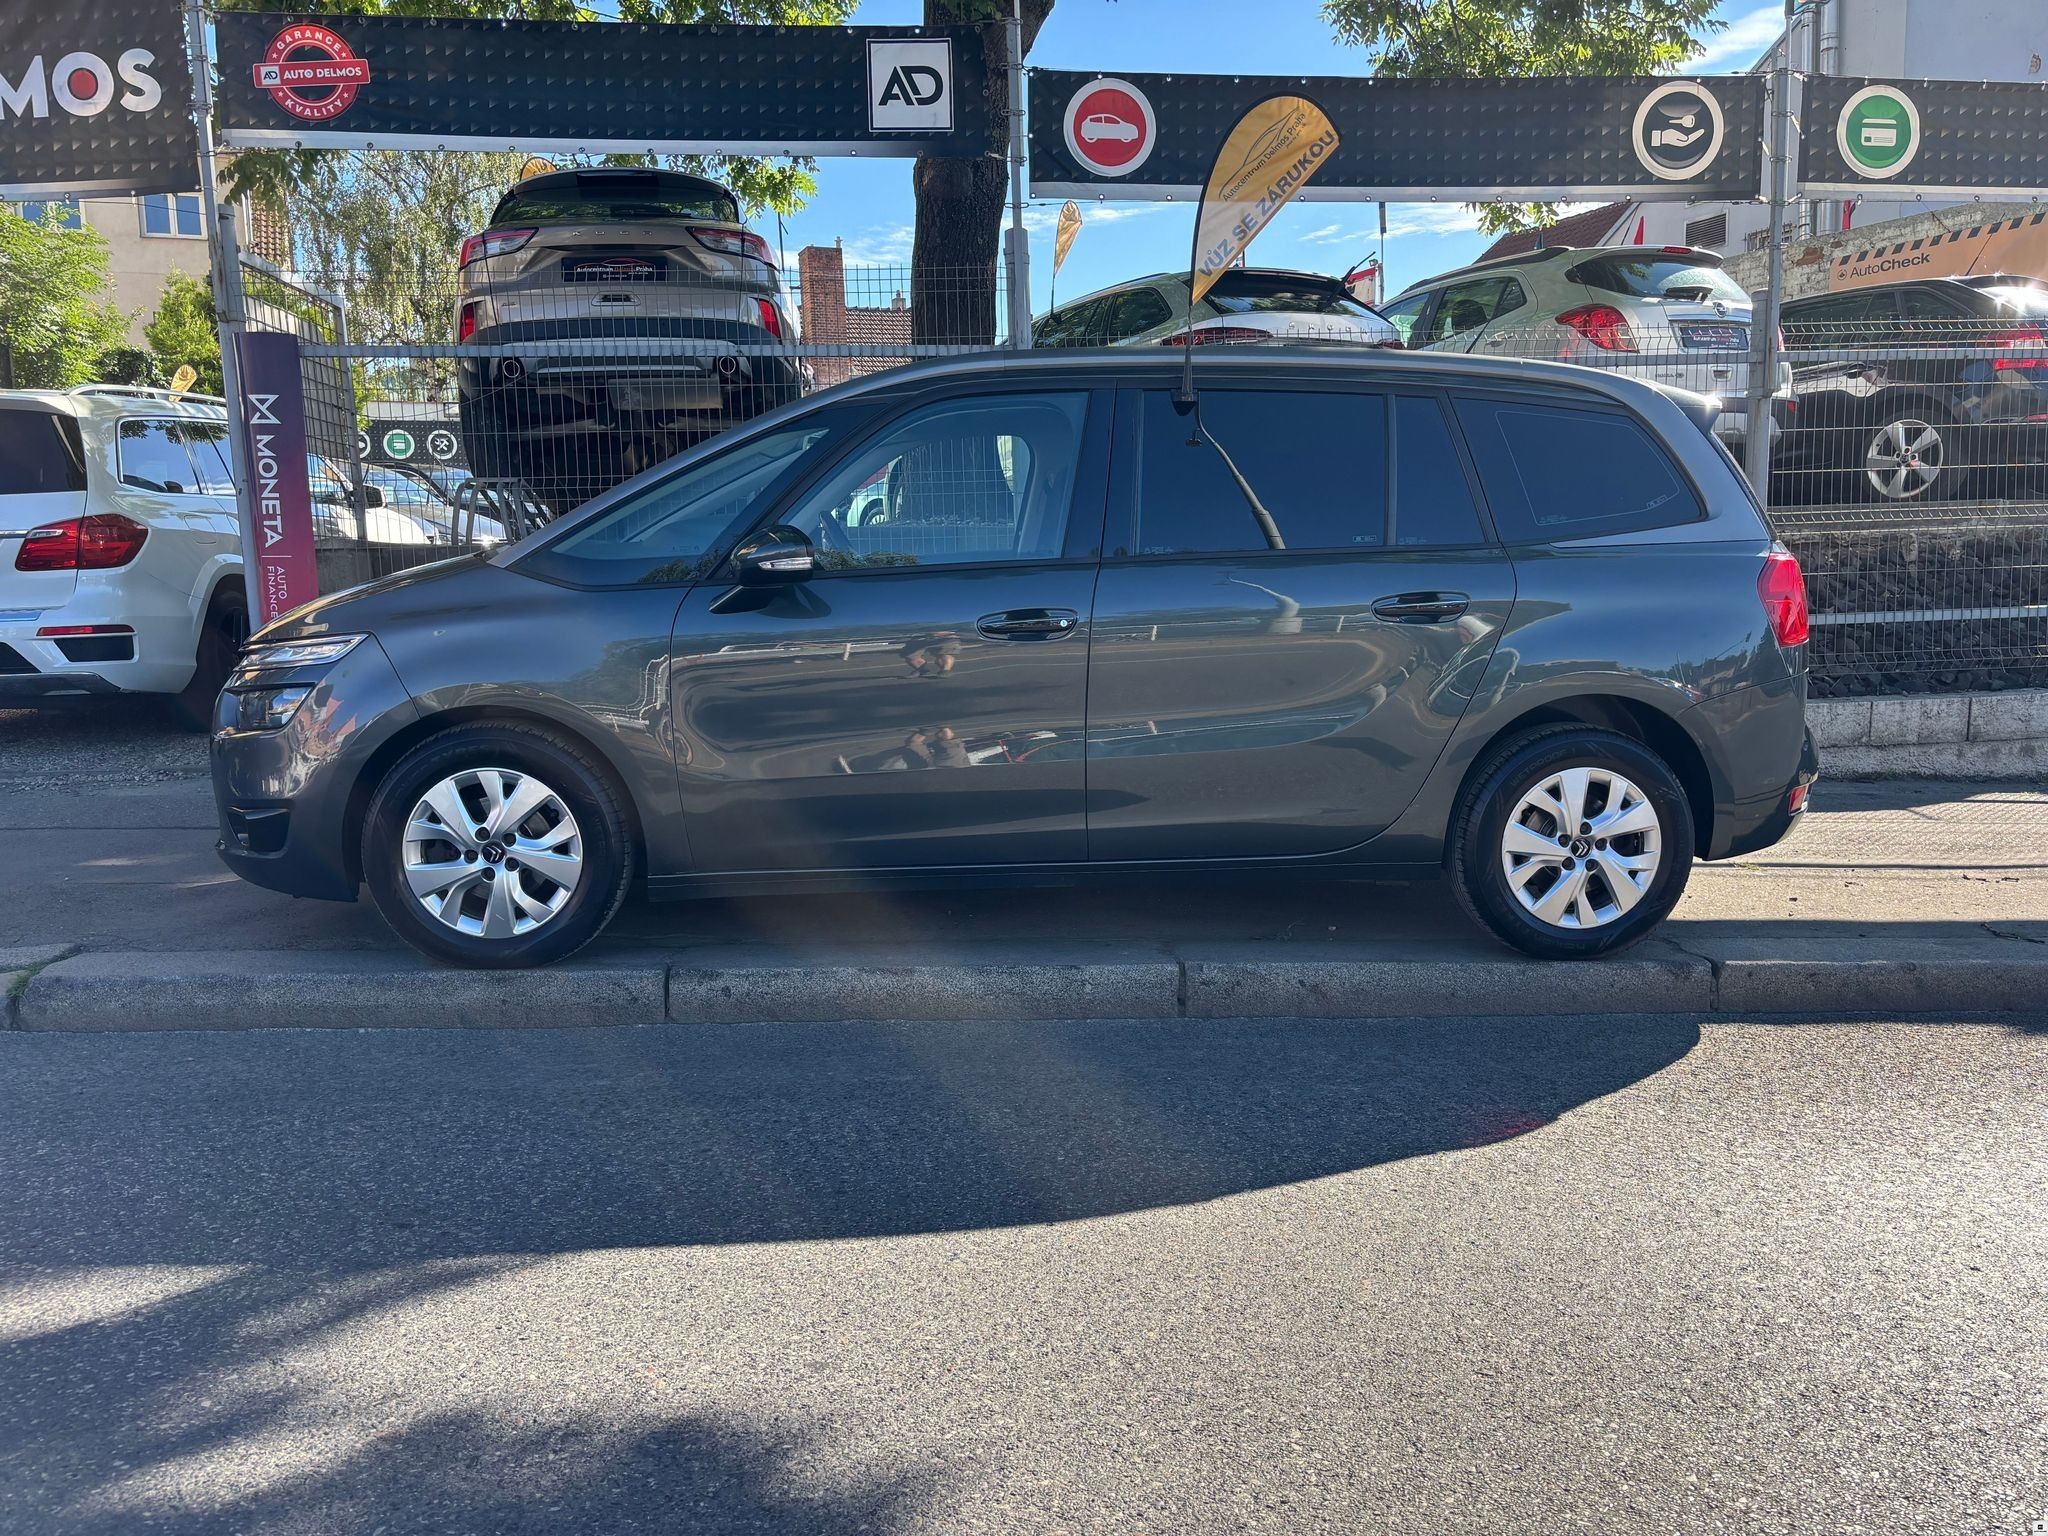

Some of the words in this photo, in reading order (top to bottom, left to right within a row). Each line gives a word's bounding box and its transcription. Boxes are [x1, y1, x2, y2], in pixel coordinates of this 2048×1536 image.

[276, 29, 342, 52] GARANCE
[0, 48, 162, 120] MOS
[263, 71, 278, 80] AD
[283, 68, 314, 80] AUTO
[316, 66, 362, 78] DELMOS
[878, 65, 944, 106] AD
[285, 98, 343, 117] KVALITY
[1222, 158, 1266, 202] Autocentrum
[1263, 135, 1290, 160] Delmos
[1287, 113, 1306, 136] Praha
[1198, 238, 1235, 278] VŮZ
[1232, 213, 1259, 242] SE
[1255, 129, 1337, 218] ZÁRUKOU
[1850, 252, 1931, 279] AutoCheck
[256, 434, 284, 548] MONETA
[267, 565, 279, 619] FINANCE
[276, 565, 288, 600] AUTO
